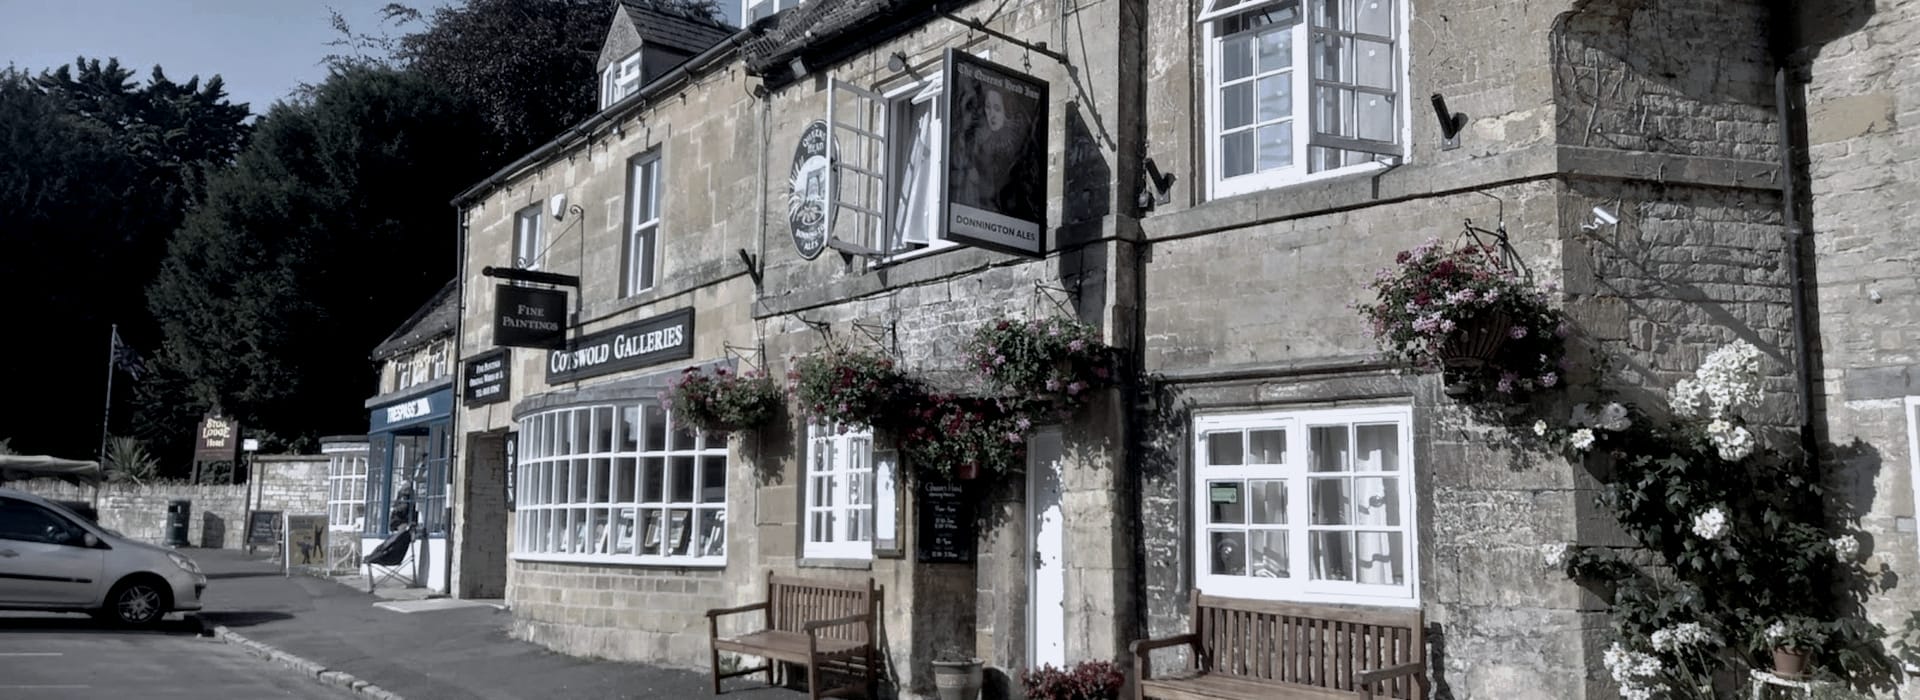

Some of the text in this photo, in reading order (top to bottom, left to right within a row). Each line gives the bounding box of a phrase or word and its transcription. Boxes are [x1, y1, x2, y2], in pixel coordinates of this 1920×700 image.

[956, 215, 1036, 241] DONNINGTON ALES
[804, 240, 819, 251] ALES
[518, 304, 545, 317] FINE
[502, 316, 559, 332] PAINTINGS
[551, 324, 683, 373] COTSWOLD GALLERIES
[202, 427, 230, 438] LODGE
